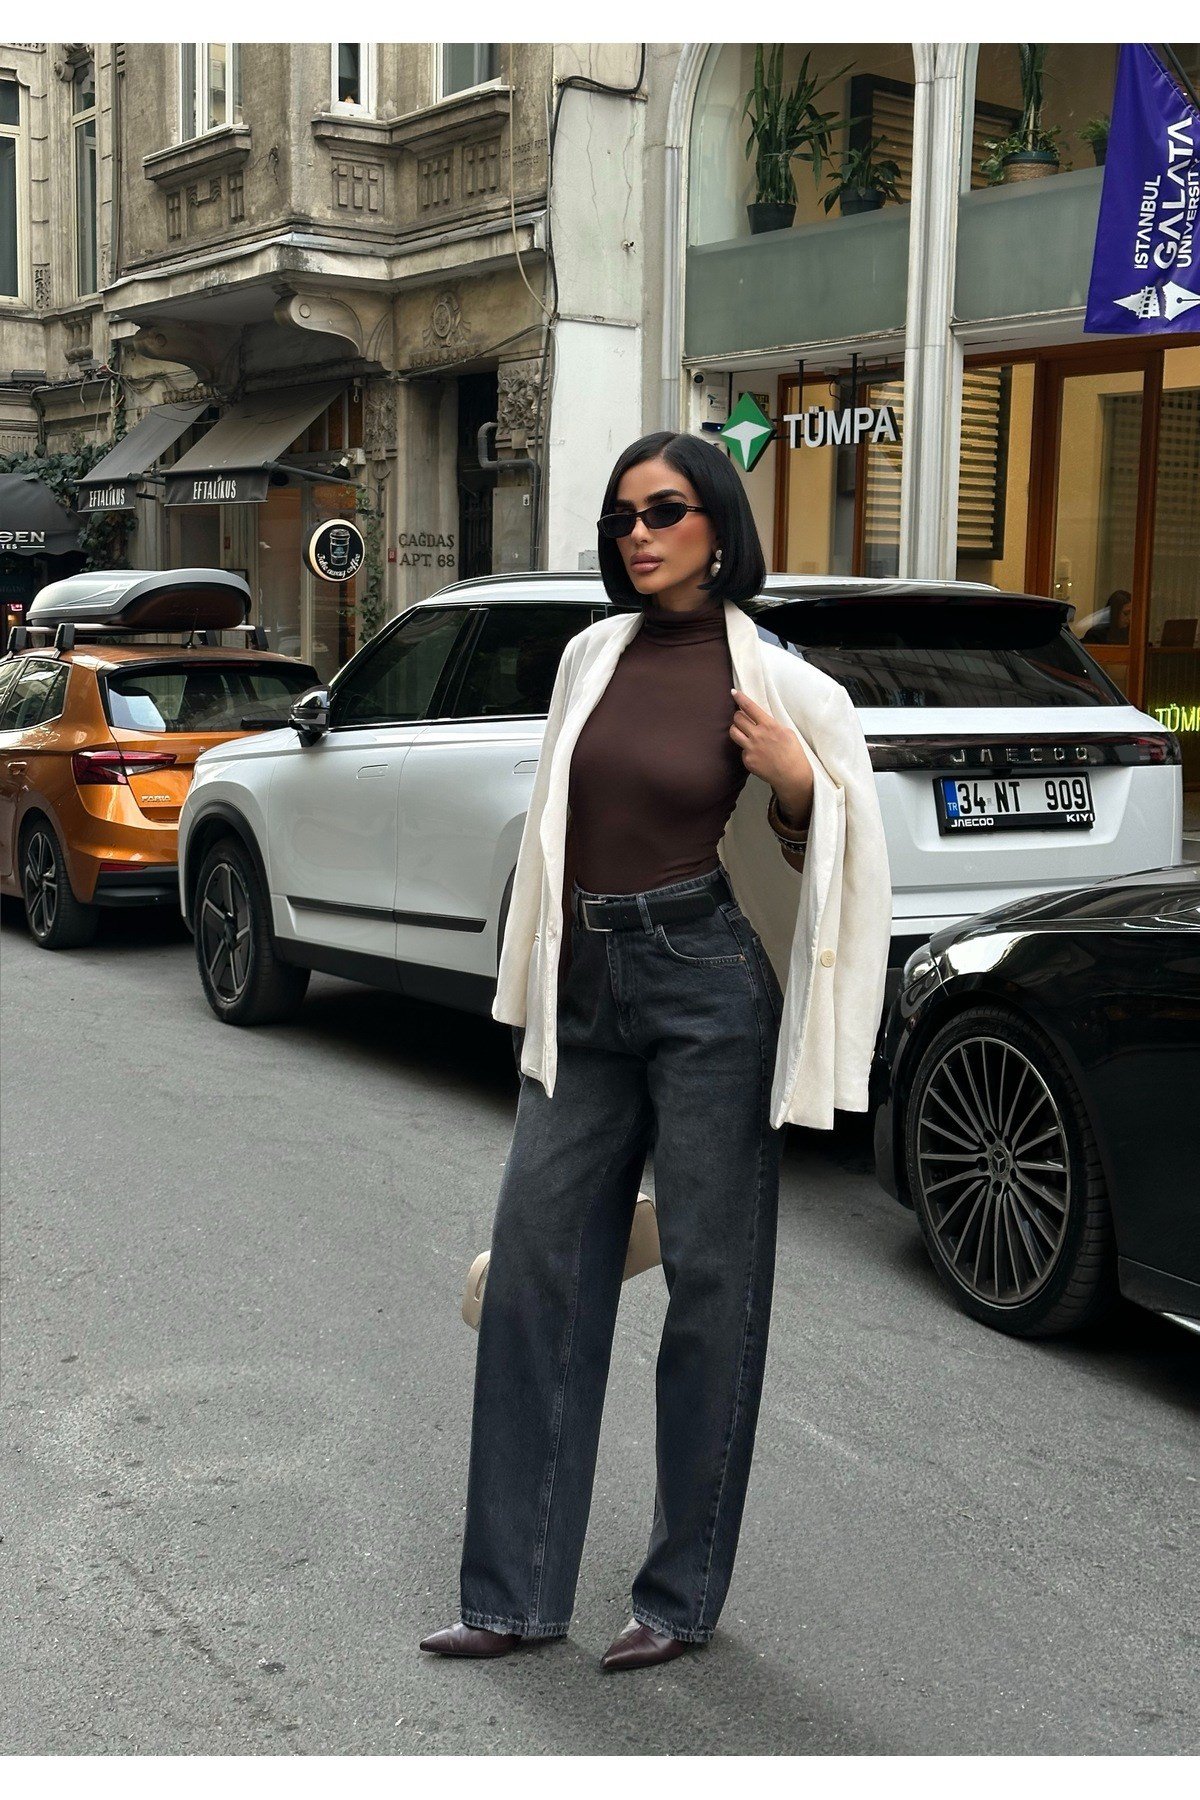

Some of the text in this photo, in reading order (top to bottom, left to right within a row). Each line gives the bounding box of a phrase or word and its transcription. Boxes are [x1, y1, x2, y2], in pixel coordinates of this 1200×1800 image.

[1153, 117, 1194, 269] GALATA
[783, 405, 897, 449] TÜMPA
[398, 532, 455, 550] ÇAĞDAŞ
[437, 554, 455, 567] 68
[951, 747, 1088, 763] JAECOO
[957, 779, 1086, 814] 34 NT 909
[947, 802, 958, 811] TR
[951, 813, 1094, 828] JAECOO KIYI
